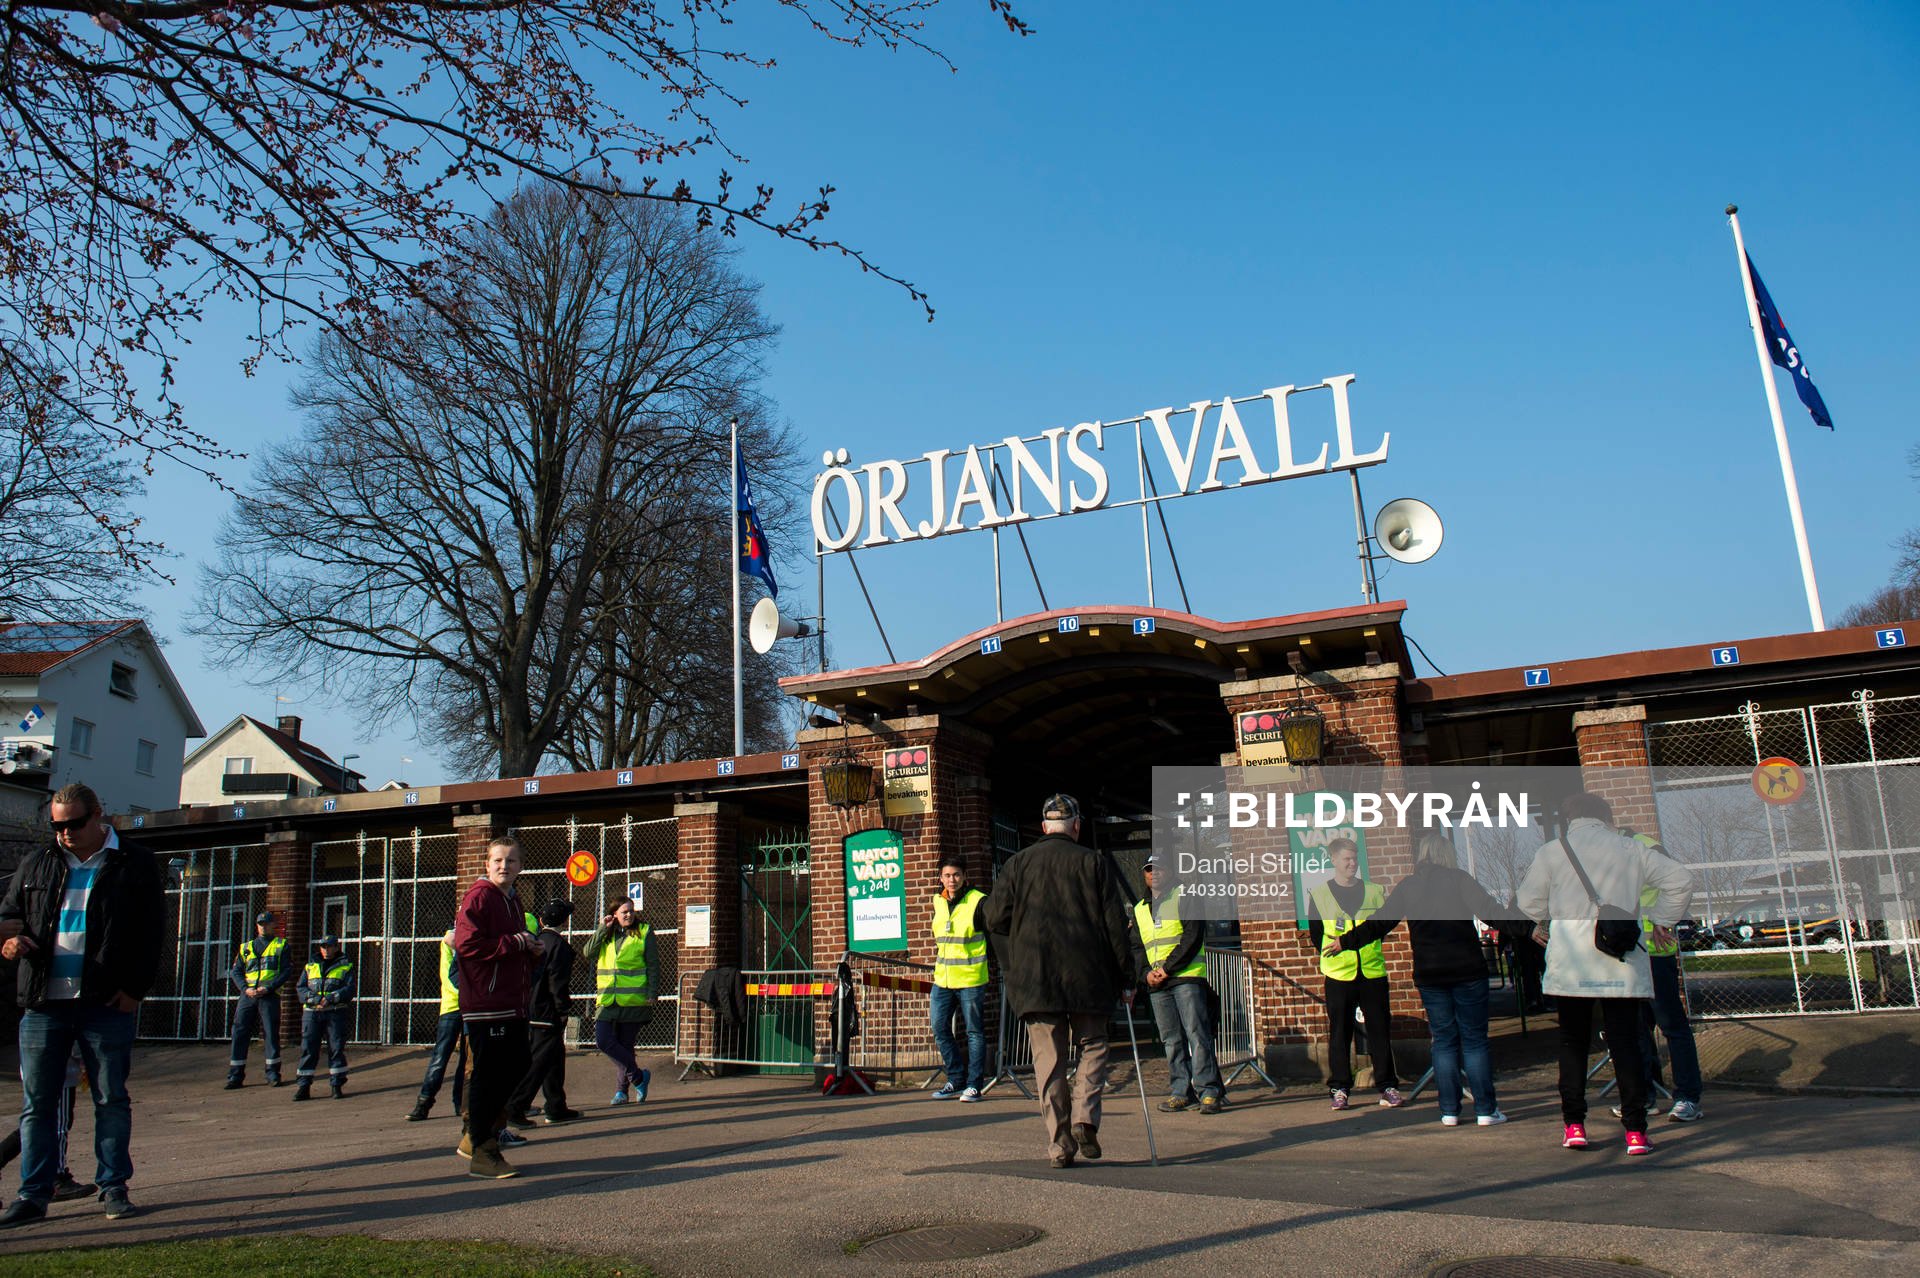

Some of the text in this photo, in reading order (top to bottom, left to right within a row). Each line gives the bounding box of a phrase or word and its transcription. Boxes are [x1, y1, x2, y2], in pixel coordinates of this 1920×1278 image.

[811, 373, 1390, 550] ÖRJANS VALL
[1061, 618, 1076, 630] 10
[1140, 619, 1148, 632] 9
[1885, 631, 1897, 645] 5
[984, 640, 998, 652] 11
[1720, 650, 1731, 663] 6
[1532, 671, 1542, 684] 7
[1244, 731, 1282, 742] SECURIT
[784, 756, 797, 767] 12
[1245, 756, 1289, 767] bevaknin
[719, 762, 732, 773] 13
[887, 766, 927, 777] SECURITAS
[619, 773, 631, 784] 14
[525, 783, 537, 792] 15
[406, 793, 417, 803] 16
[888, 789, 928, 800] bevakning
[325, 801, 334, 810] 17
[134, 816, 143, 826] 19
[852, 847, 899, 863] MATCH
[852, 860, 900, 881] VÅRD
[869, 878, 890, 891] dag
